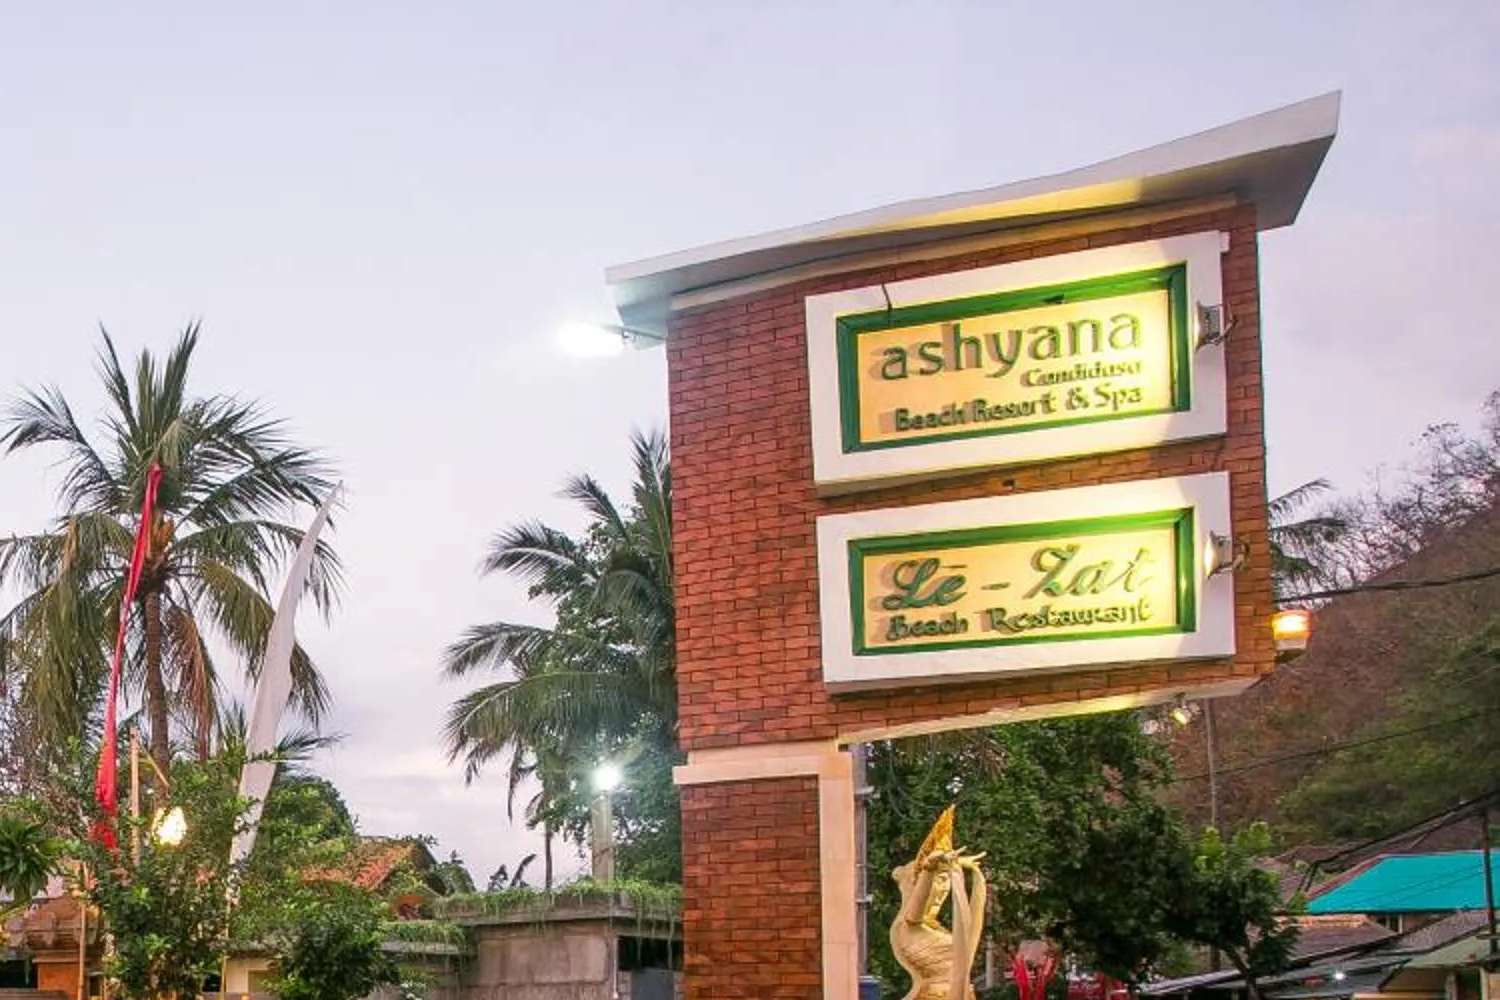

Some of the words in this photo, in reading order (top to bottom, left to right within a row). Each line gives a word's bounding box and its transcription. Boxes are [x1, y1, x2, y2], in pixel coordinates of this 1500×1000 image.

[879, 312, 1141, 380] ashyana
[895, 403, 966, 432] Beach
[972, 394, 1057, 423] Resort
[1065, 387, 1090, 411] &
[1094, 381, 1142, 412] Spa
[886, 612, 969, 641] Beach
[989, 600, 1153, 634] Restaurant
